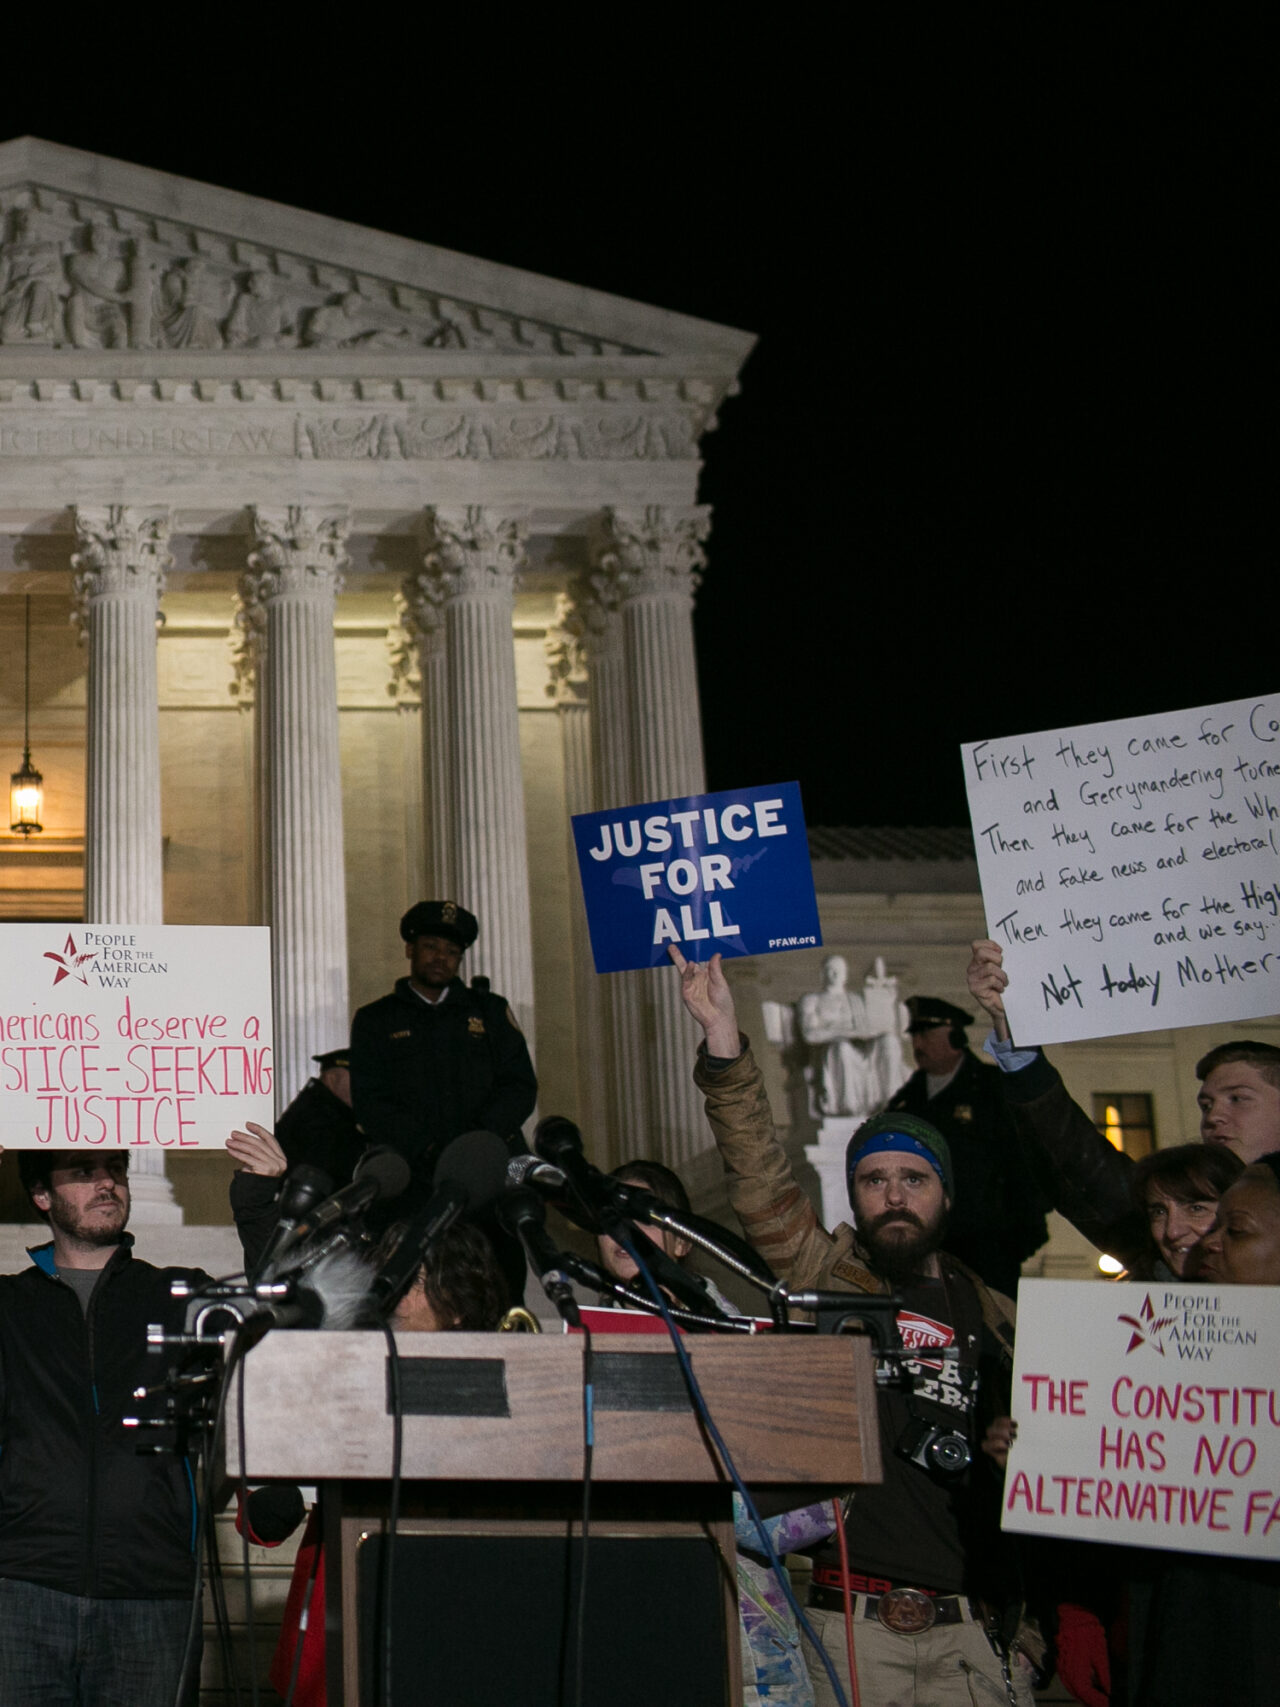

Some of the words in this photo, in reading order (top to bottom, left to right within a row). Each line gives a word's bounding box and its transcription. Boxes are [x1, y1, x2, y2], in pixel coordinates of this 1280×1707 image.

[972, 742, 1036, 781] First
[1056, 738, 1114, 778] they
[1127, 734, 1187, 756] came
[1198, 718, 1234, 745] for
[1023, 789, 1059, 814] and
[1079, 767, 1224, 810] Gerrymandering
[589, 798, 788, 862] JUSTICE
[981, 823, 1035, 855] Then
[1052, 823, 1096, 853] they
[1111, 819, 1155, 838] came
[1165, 813, 1200, 834] for
[1209, 807, 1237, 829] the
[639, 854, 736, 900] FOR
[1016, 871, 1046, 896] and
[1058, 866, 1104, 888] fake
[1111, 860, 1147, 878] news
[1156, 847, 1188, 870] and
[1202, 829, 1280, 862] electoral
[84, 932, 136, 946] PEOPLE
[653, 900, 740, 945] ALL
[768, 936, 816, 948] PFAW.org
[995, 910, 1048, 945] Then
[1059, 908, 1105, 942] they
[1108, 910, 1152, 928] came
[1162, 897, 1192, 920] for
[1200, 896, 1235, 915] the
[1153, 927, 1188, 946] and
[1199, 923, 1226, 940] we
[90, 960, 168, 974] AMERICAN
[103, 947, 133, 961] FOR
[135, 951, 155, 960] THE
[98, 975, 131, 989] WAY
[1041, 964, 1084, 1012] Not
[1100, 962, 1161, 1007] today
[117, 995, 227, 1040] deserve
[243, 1016, 260, 1041] a
[35, 1095, 200, 1146] JUSTICE
[1163, 1292, 1221, 1311] PEOPLE
[1184, 1310, 1216, 1328] FOR
[1168, 1328, 1257, 1345] AMERICAN
[1177, 1343, 1214, 1361] WAY
[1022, 1374, 1088, 1416] THE
[1099, 1424, 1167, 1472] HAS
[1194, 1434, 1257, 1478] NO
[1006, 1471, 1234, 1532] ALTERNATIVE
